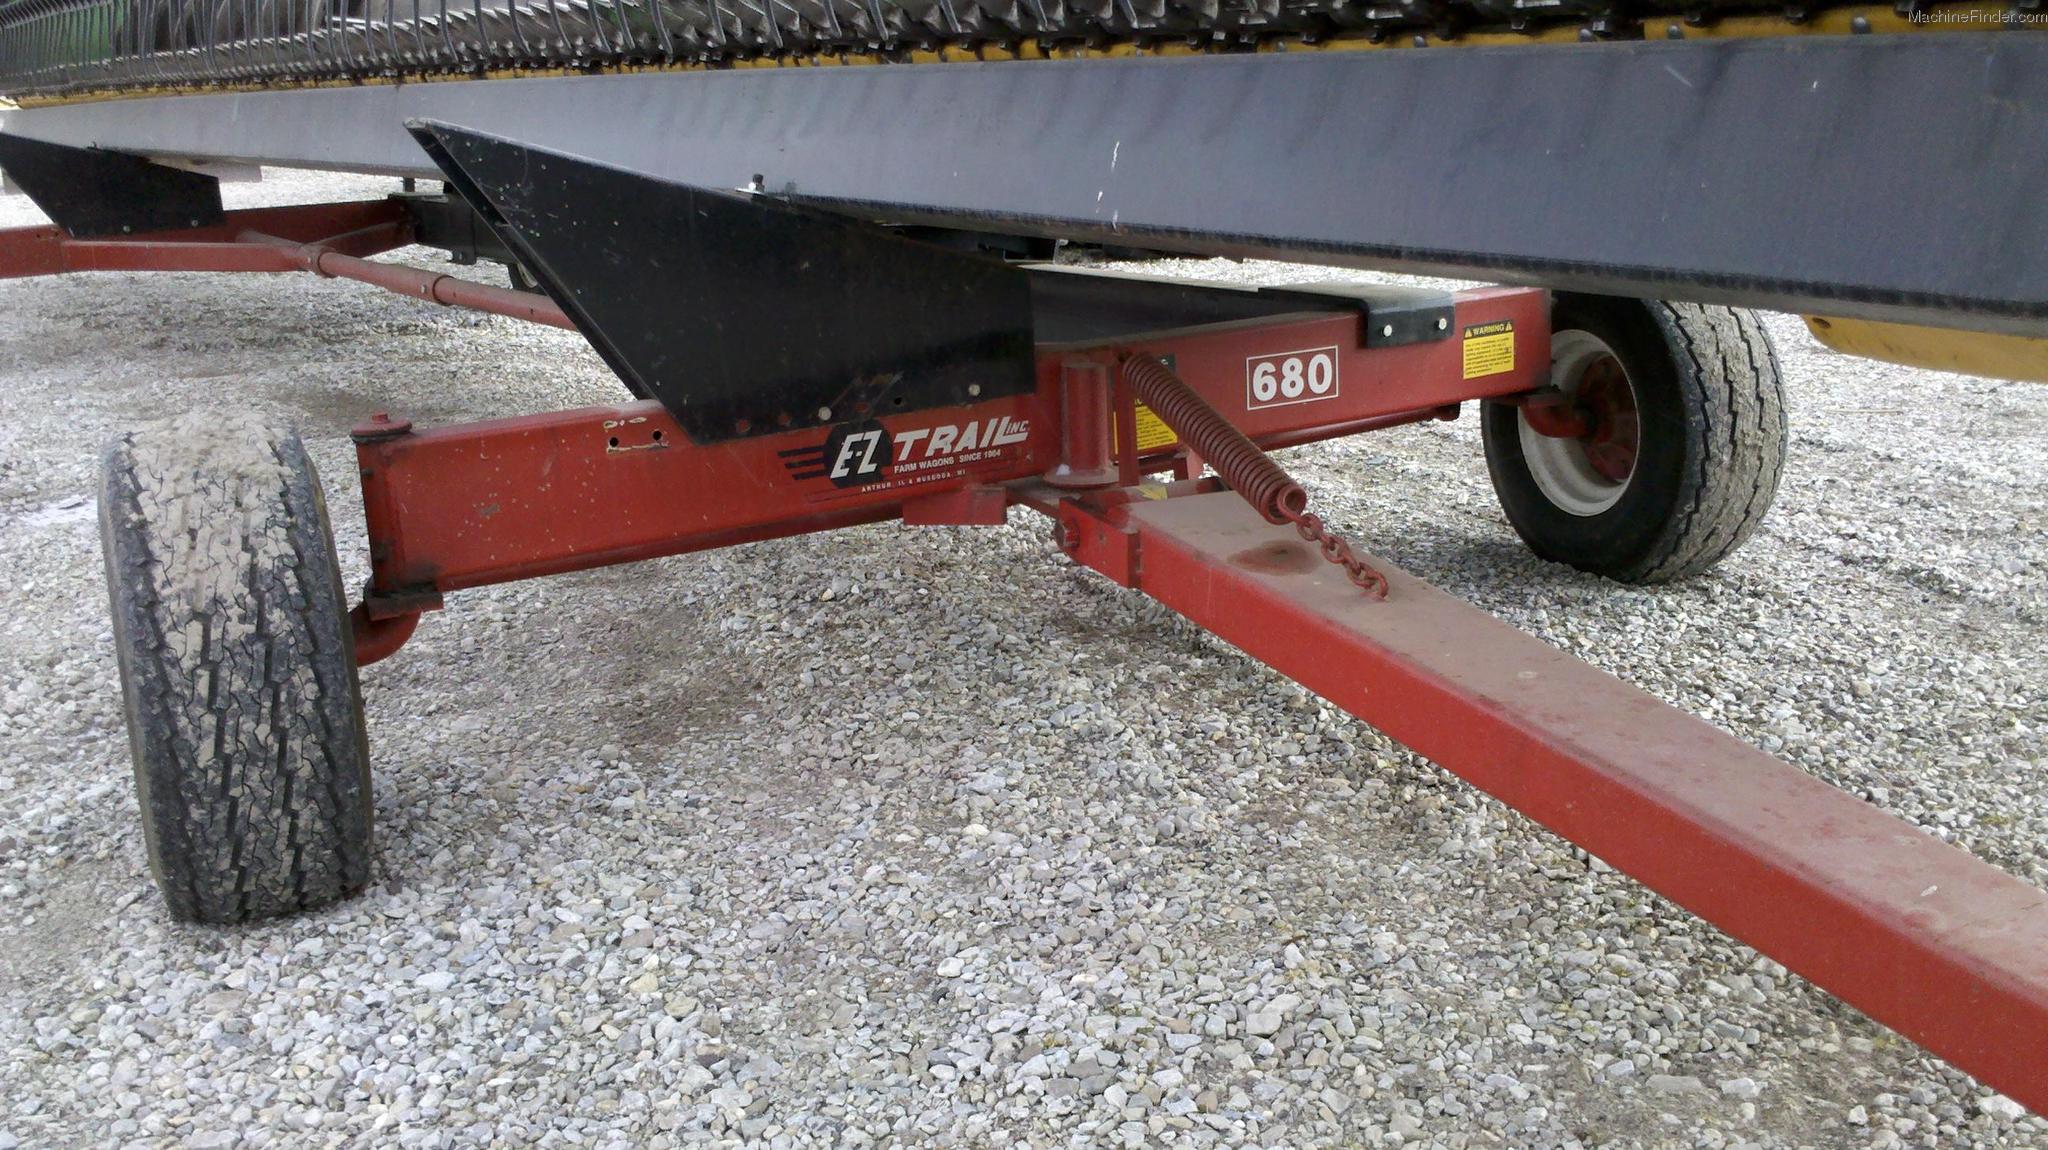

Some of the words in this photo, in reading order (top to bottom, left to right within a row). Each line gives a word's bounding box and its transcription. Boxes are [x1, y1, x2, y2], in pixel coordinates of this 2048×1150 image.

[1472, 323, 1505, 336] WARNING
[1253, 354, 1333, 401] 680
[893, 416, 1028, 462] TRAIL
[894, 462, 917, 474] FARM
[919, 456, 954, 469] WAGONS
[959, 451, 982, 463] SINCE
